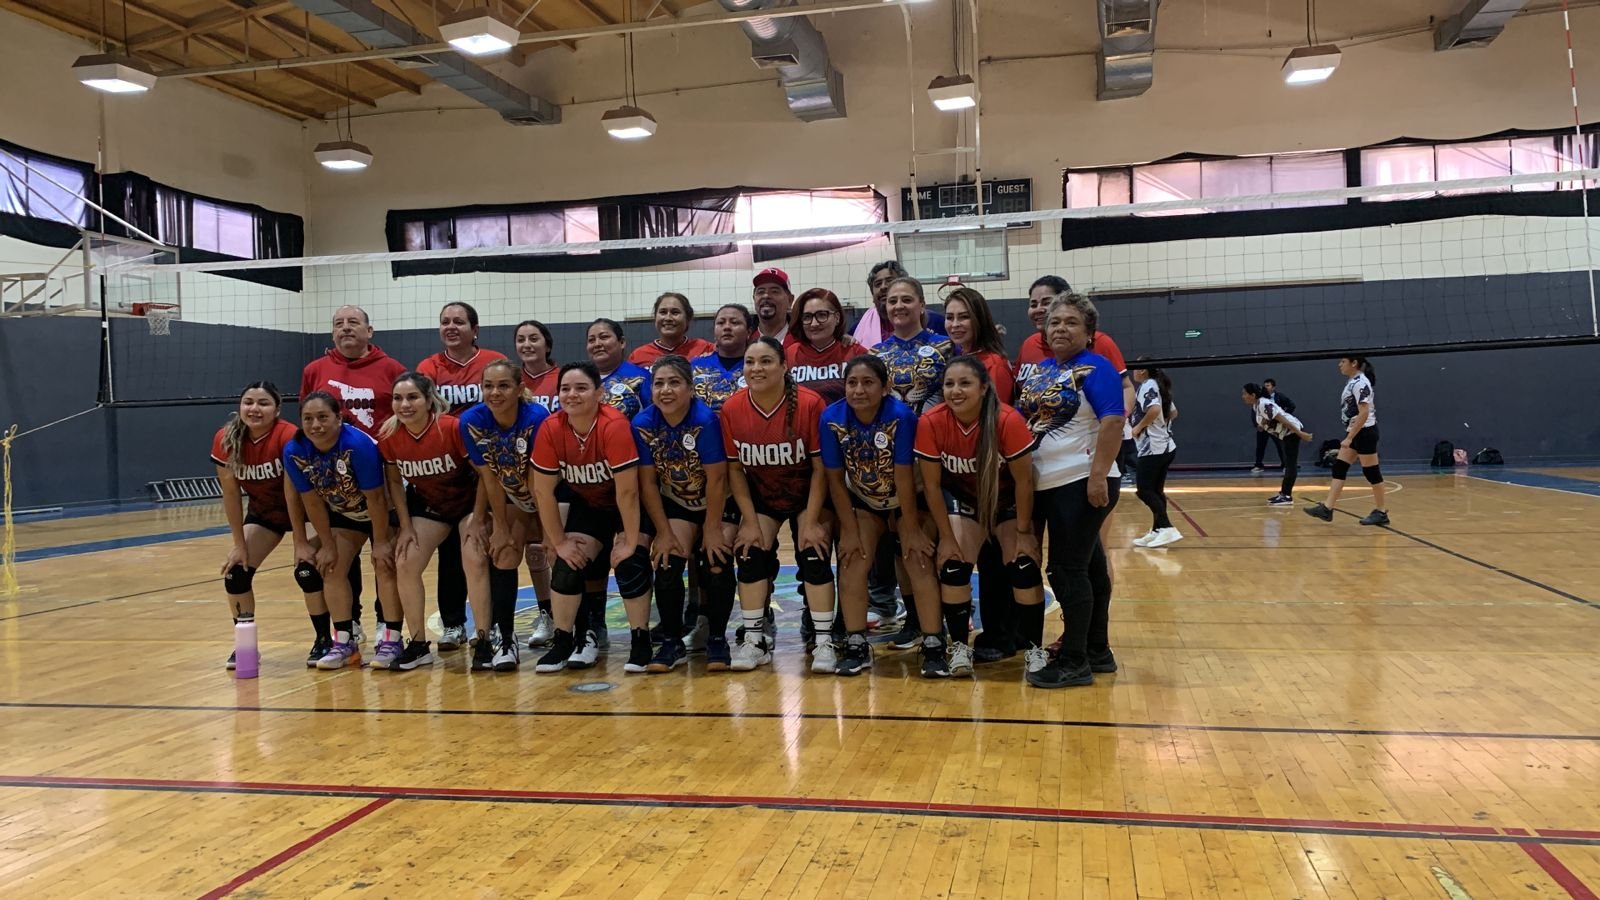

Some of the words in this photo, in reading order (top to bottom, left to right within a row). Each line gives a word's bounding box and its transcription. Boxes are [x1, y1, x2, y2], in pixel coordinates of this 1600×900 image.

[907, 191, 932, 201] HME
[997, 184, 1025, 195] GUEST
[436, 383, 484, 405] ONO
[396, 453, 458, 478] SONORA
